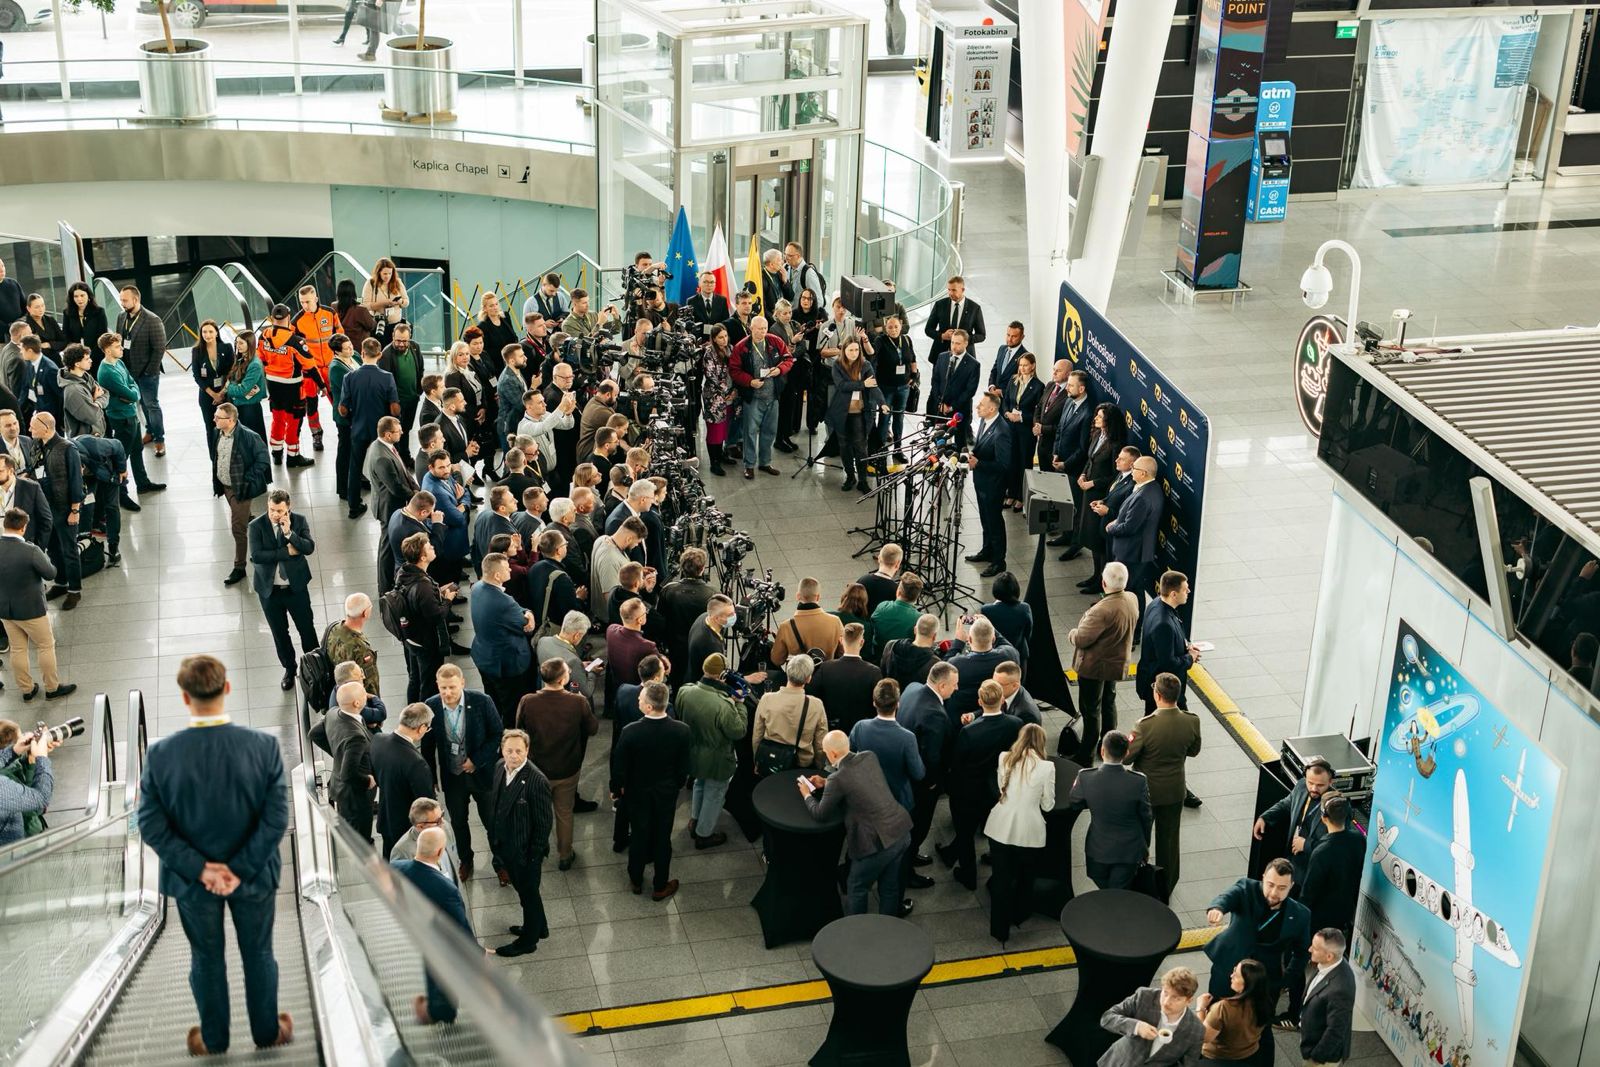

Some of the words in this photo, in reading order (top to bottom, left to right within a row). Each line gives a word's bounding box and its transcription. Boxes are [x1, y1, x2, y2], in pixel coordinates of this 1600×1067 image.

[1228, 3, 1265, 14] POINT
[1262, 88, 1291, 99] atm
[413, 160, 449, 171] Kaplica
[455, 162, 488, 175] Chapel
[1260, 206, 1285, 215] CASH
[1087, 330, 1117, 367] Dolnośląski
[1086, 344, 1108, 374] Kongres
[1085, 358, 1121, 404] Samorządowy
